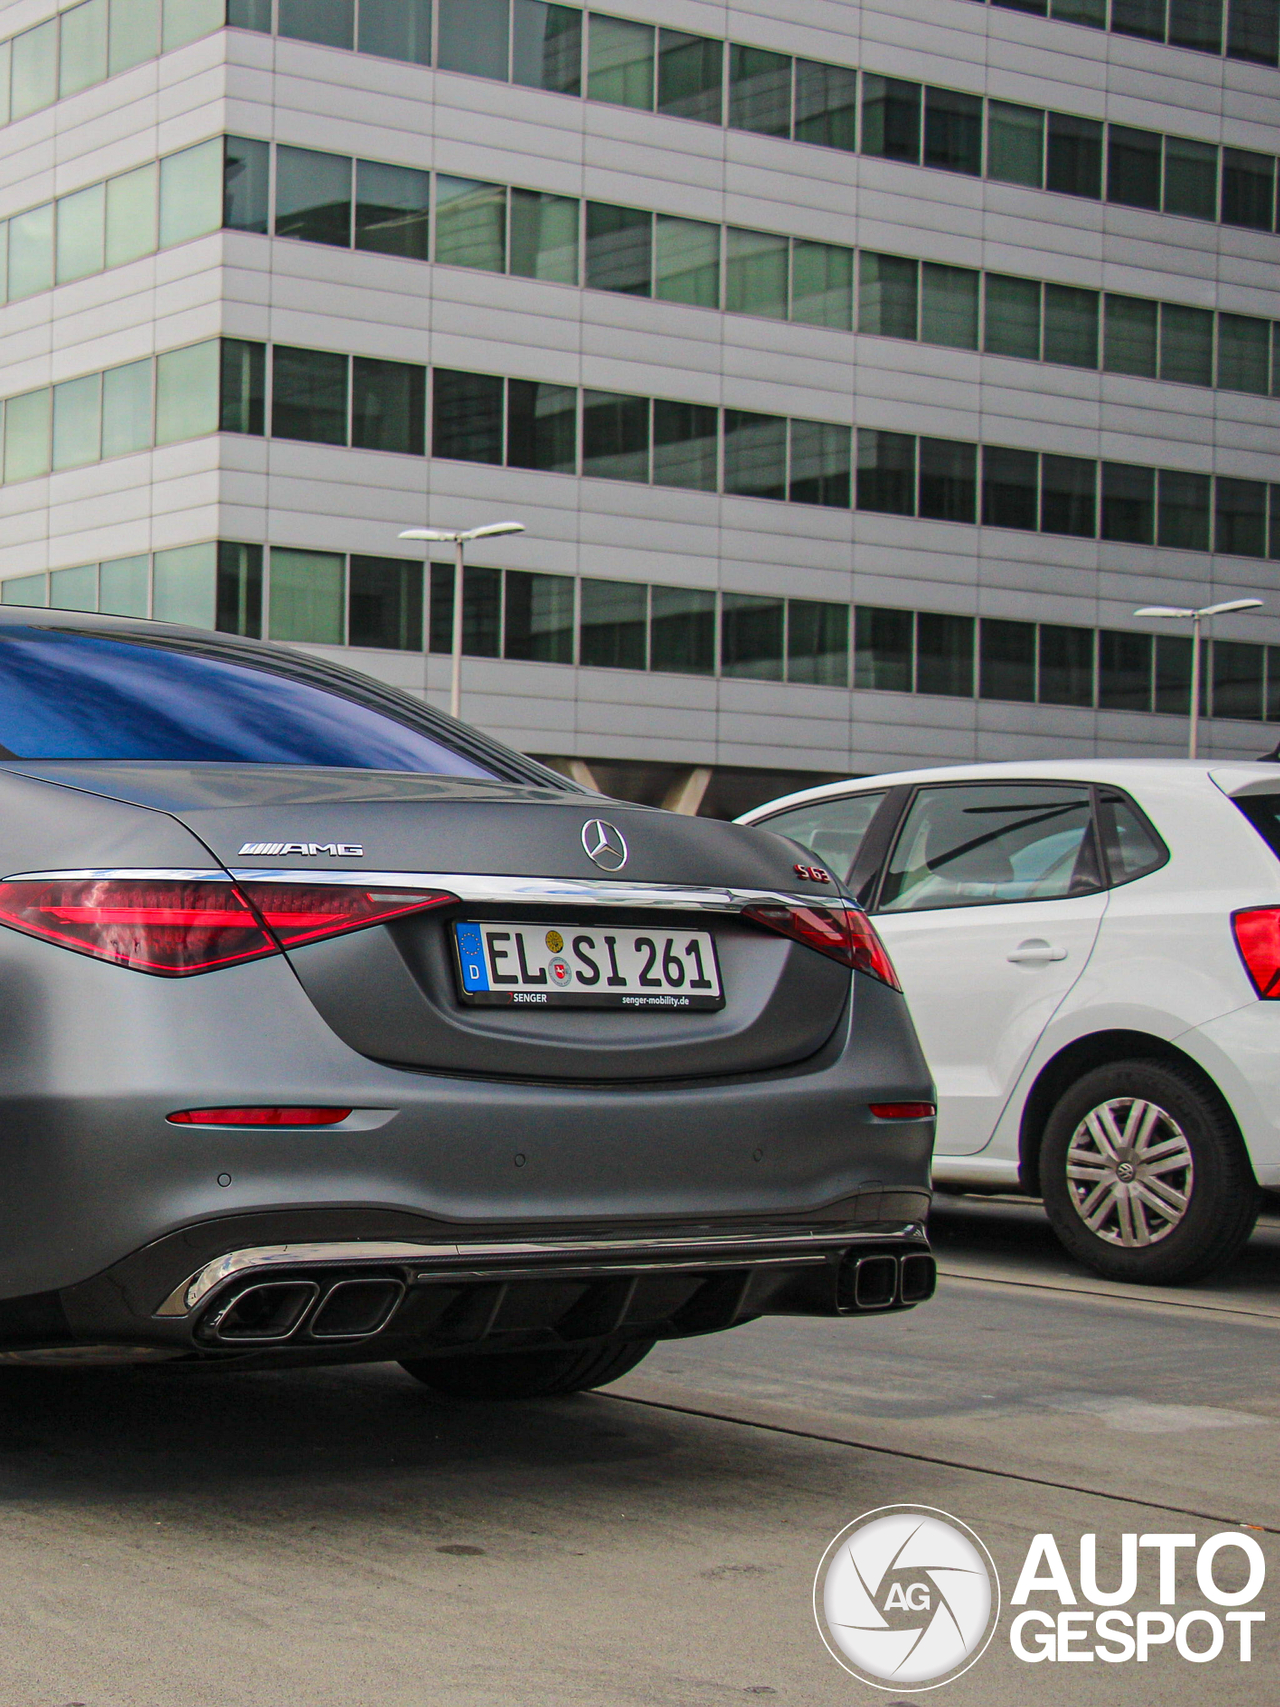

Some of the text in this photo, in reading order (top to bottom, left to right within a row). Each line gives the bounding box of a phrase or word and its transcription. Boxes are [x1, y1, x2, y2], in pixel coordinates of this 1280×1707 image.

[279, 843, 363, 857] AMG
[486, 932, 547, 985] EL
[572, 935, 627, 987] SI
[634, 937, 712, 989] 261
[469, 964, 480, 980] D
[513, 992, 547, 1003] SENGER
[622, 995, 689, 1007] senger-mobility.de
